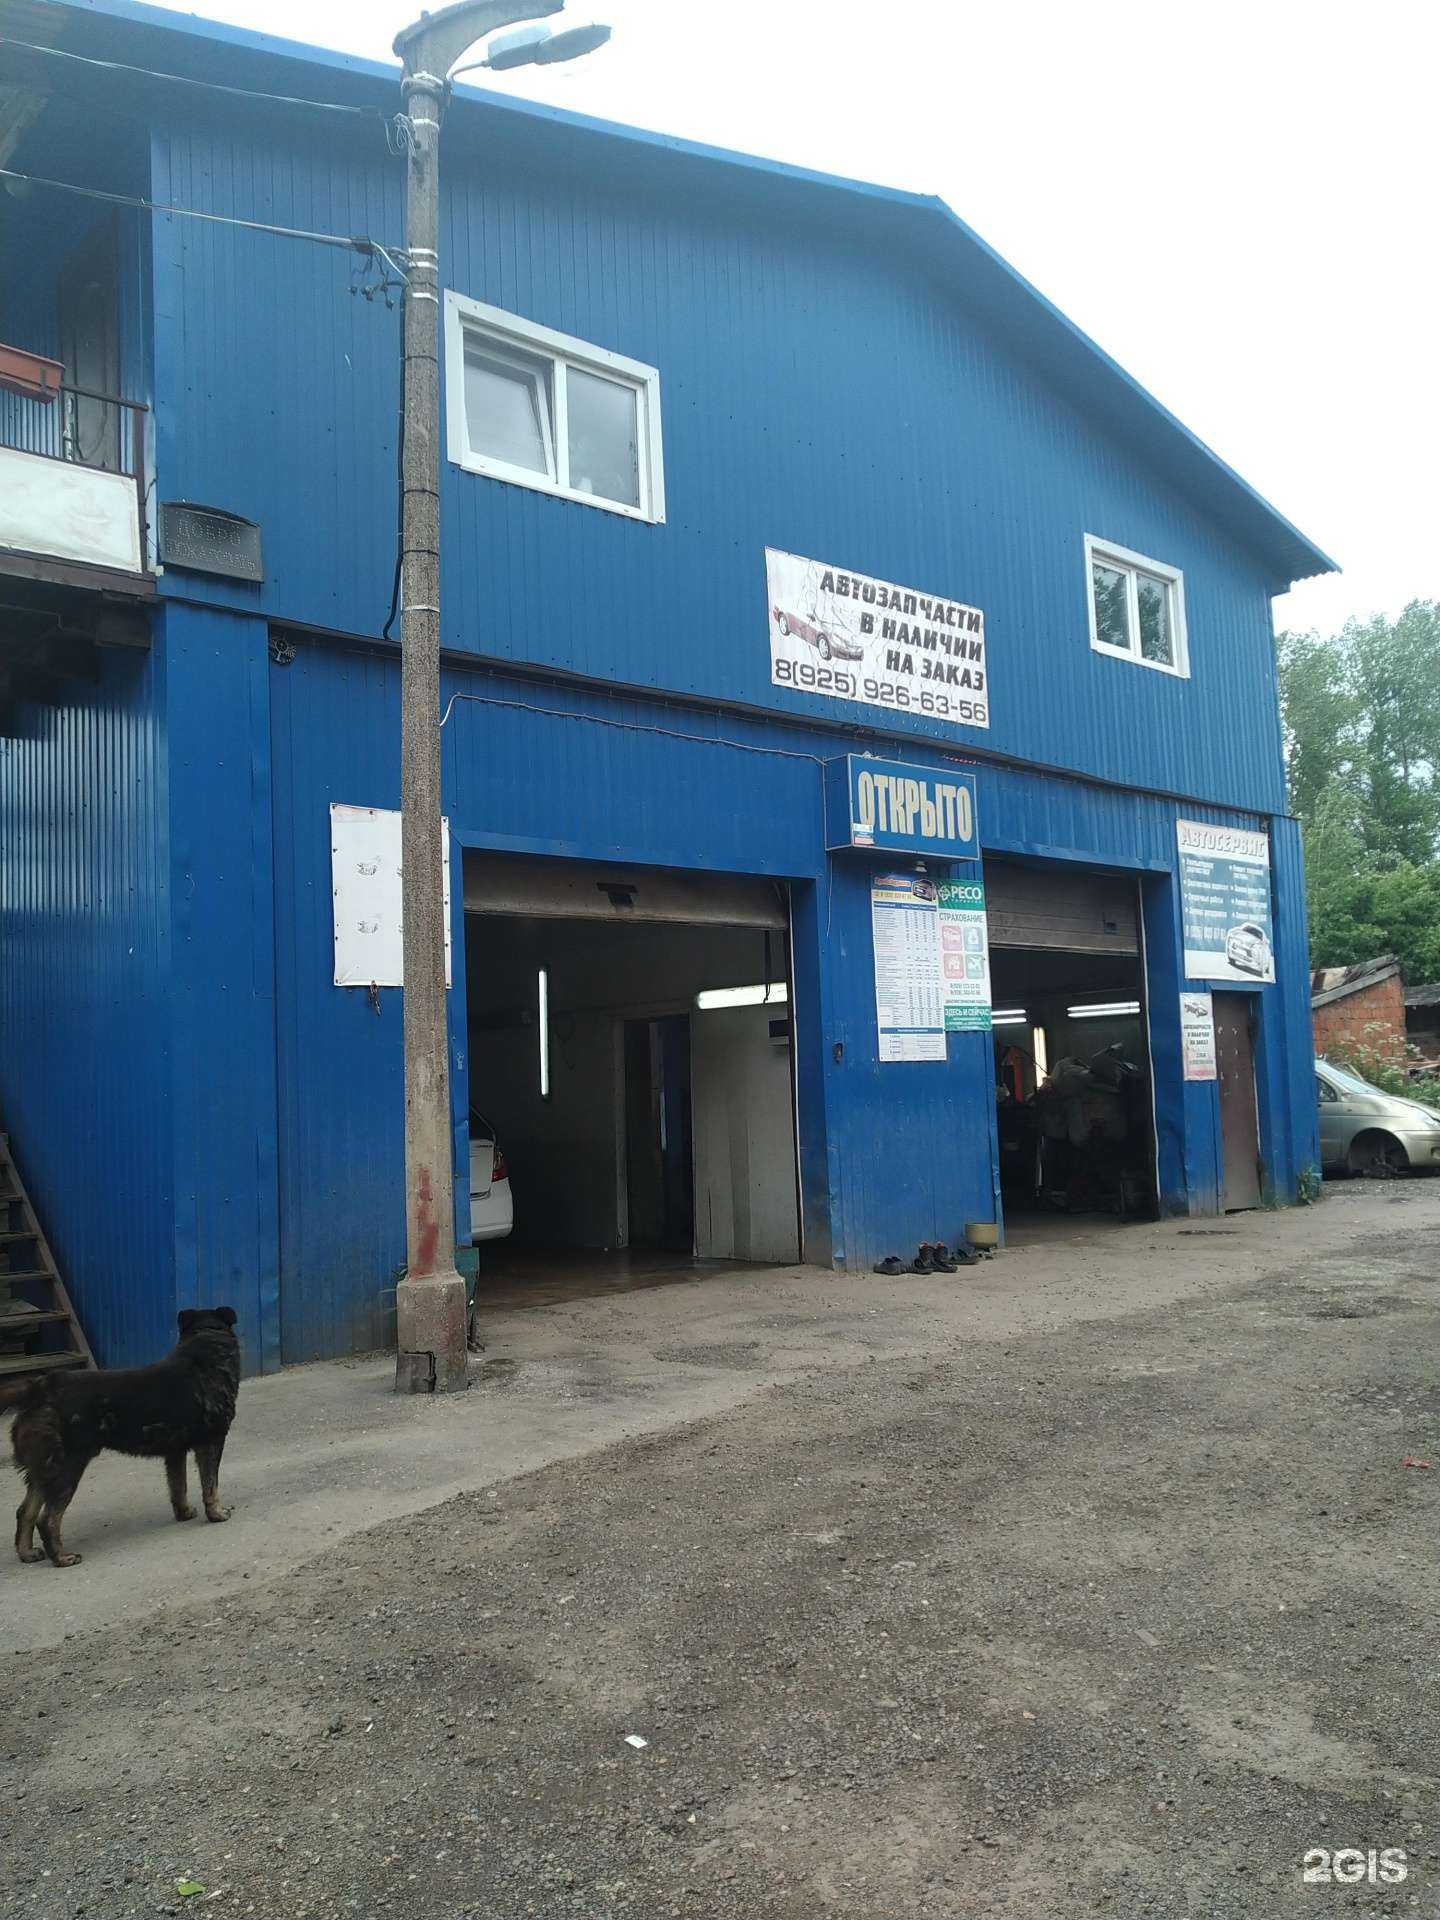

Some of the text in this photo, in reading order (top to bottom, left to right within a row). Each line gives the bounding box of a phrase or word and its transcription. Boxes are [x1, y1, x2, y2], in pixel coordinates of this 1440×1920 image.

[820, 571, 981, 633] АВТОЗАПЧАСТИ
[861, 612, 982, 662] В НАЛИЧИИ
[775, 658, 987, 722] 8(925) 926-63-56
[886, 649, 984, 691] НА ЗАКАЗ
[858, 771, 972, 842] ОТКРЫТО
[939, 912, 984, 923] СТРАХОВАНИЕ
[951, 885, 982, 900] РЕСО
